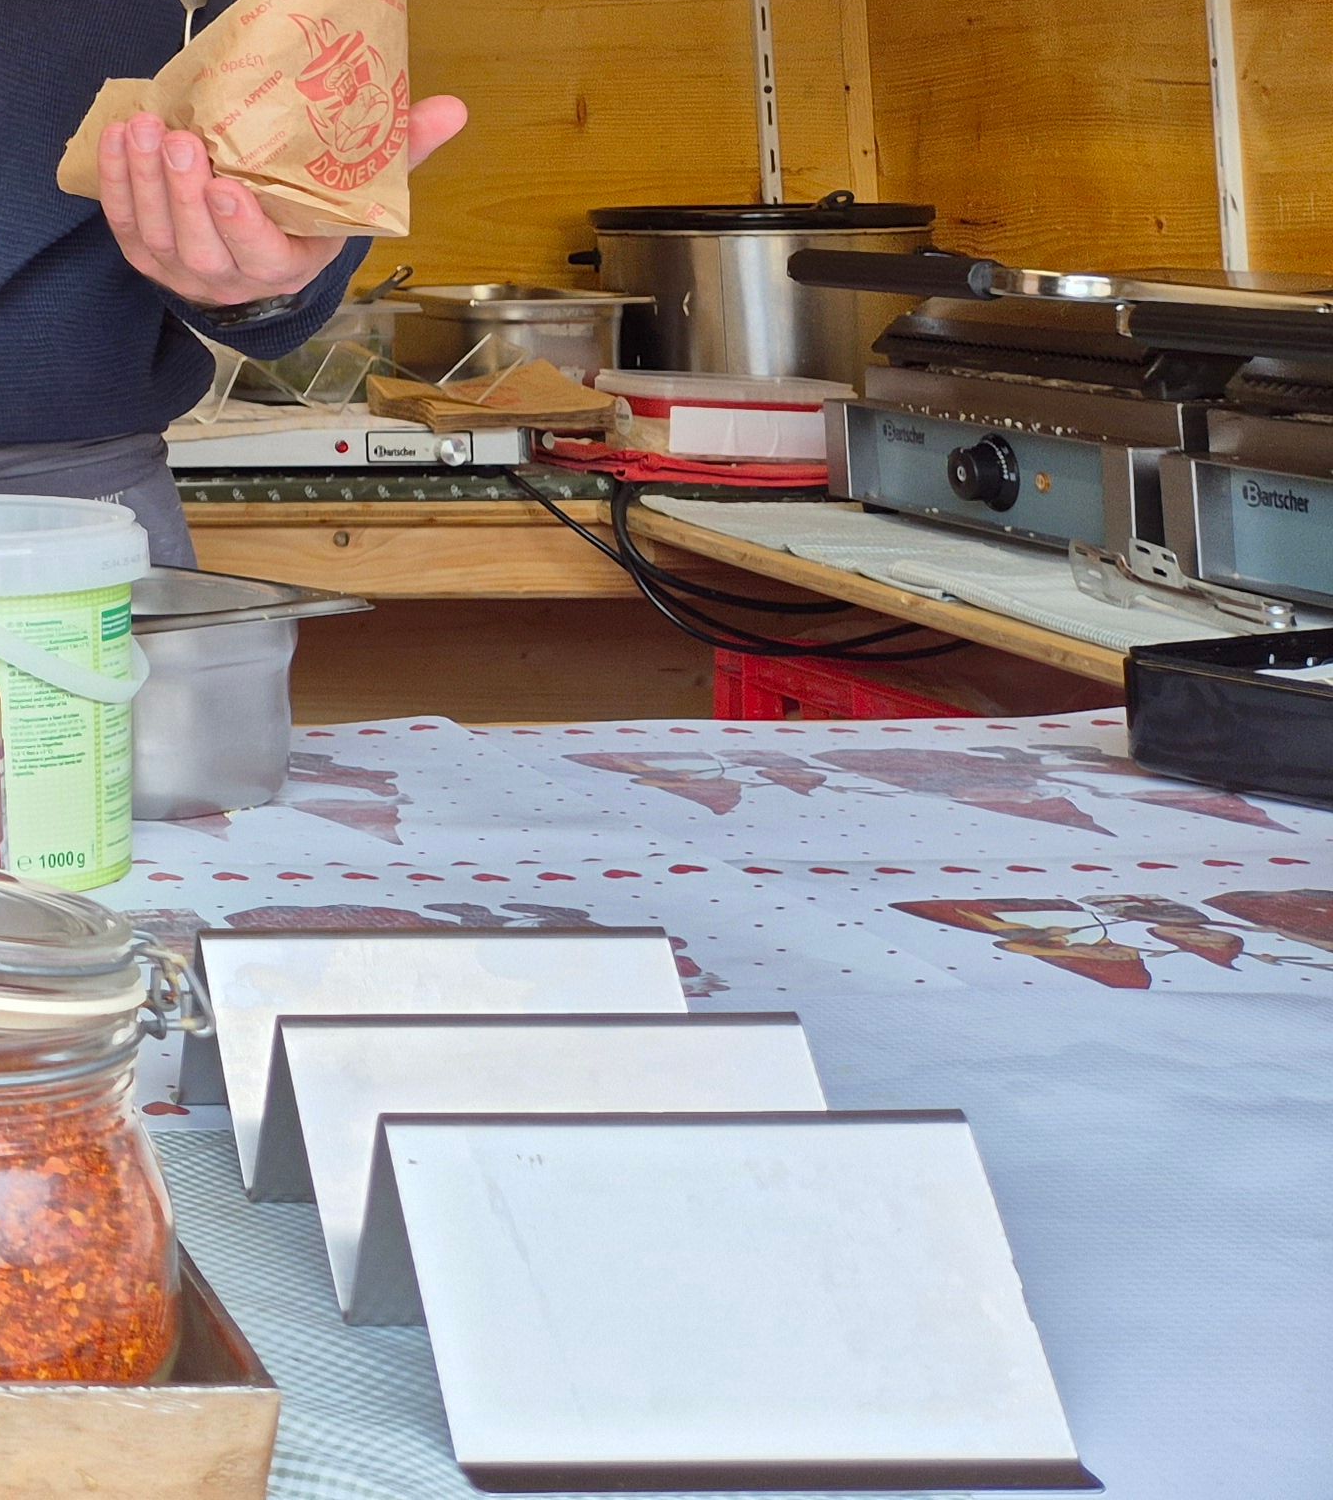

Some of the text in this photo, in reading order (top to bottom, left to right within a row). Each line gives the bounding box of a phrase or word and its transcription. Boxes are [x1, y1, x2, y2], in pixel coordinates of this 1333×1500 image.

[309, 77, 410, 190] DÖNER KEBAB
[883, 420, 926, 445] Bartscher
[1242, 479, 1310, 514] Bartscher
[38, 851, 75, 869] 1000
